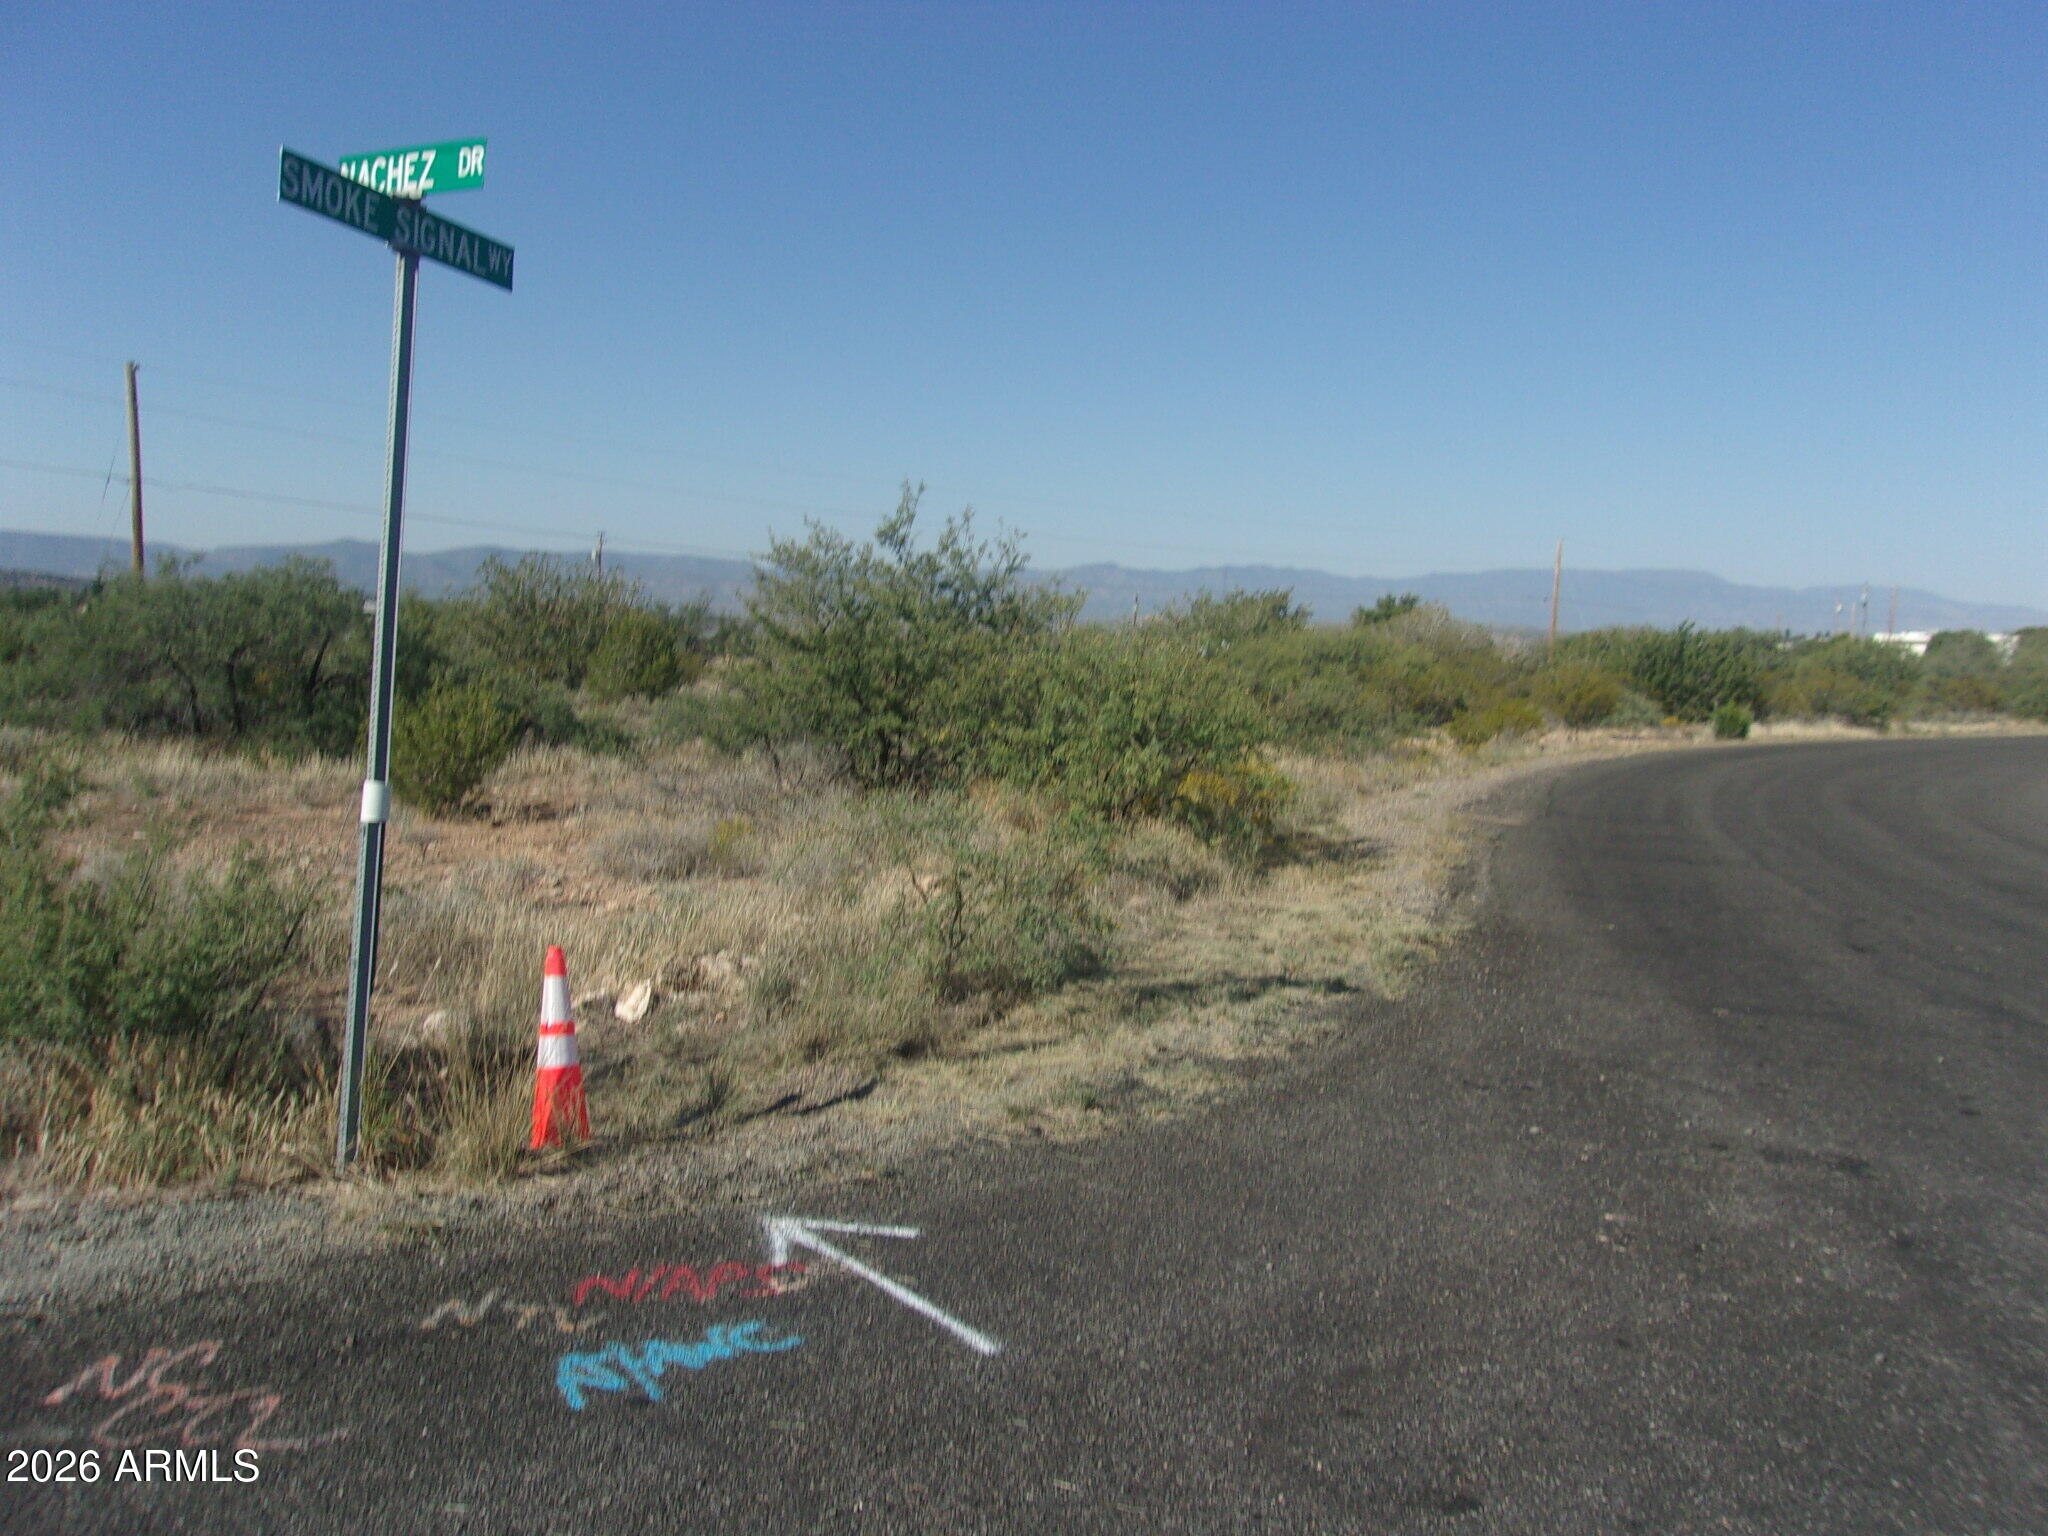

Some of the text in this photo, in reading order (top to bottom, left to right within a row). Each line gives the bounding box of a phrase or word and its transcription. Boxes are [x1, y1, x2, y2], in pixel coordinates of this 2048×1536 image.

[458, 144, 485, 179] DR
[282, 156, 512, 277] SMOKE SIGNAL WY
